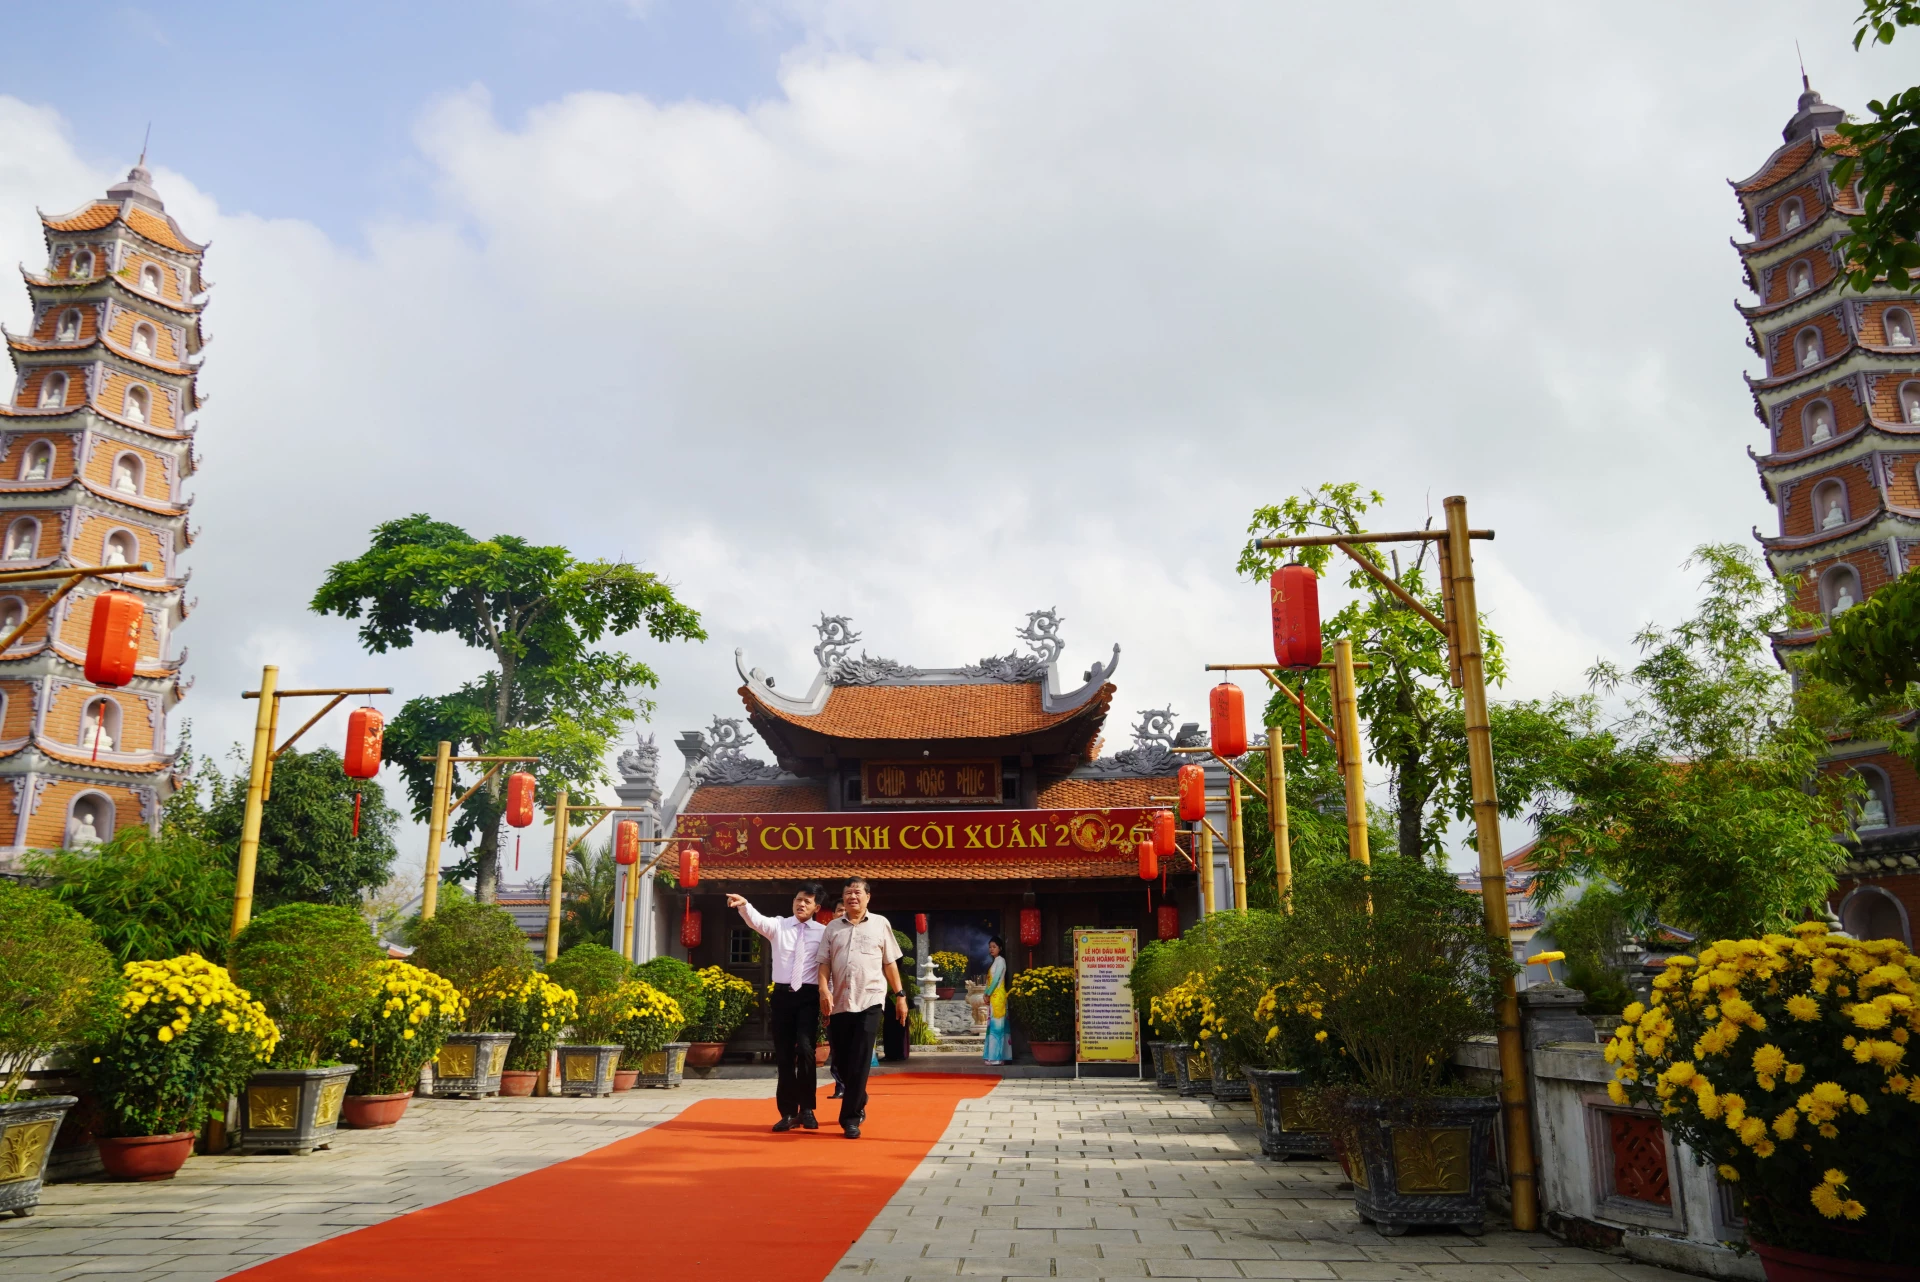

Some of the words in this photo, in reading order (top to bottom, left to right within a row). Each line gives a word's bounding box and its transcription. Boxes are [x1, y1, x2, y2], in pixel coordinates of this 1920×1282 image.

[877, 766, 906, 797] CHÙA
[957, 765, 985, 796] PHÚC
[759, 822, 815, 851] CÕI
[823, 825, 891, 855] TỊNH
[899, 821, 956, 850] CÕI
[964, 818, 1048, 849] XUÂN
